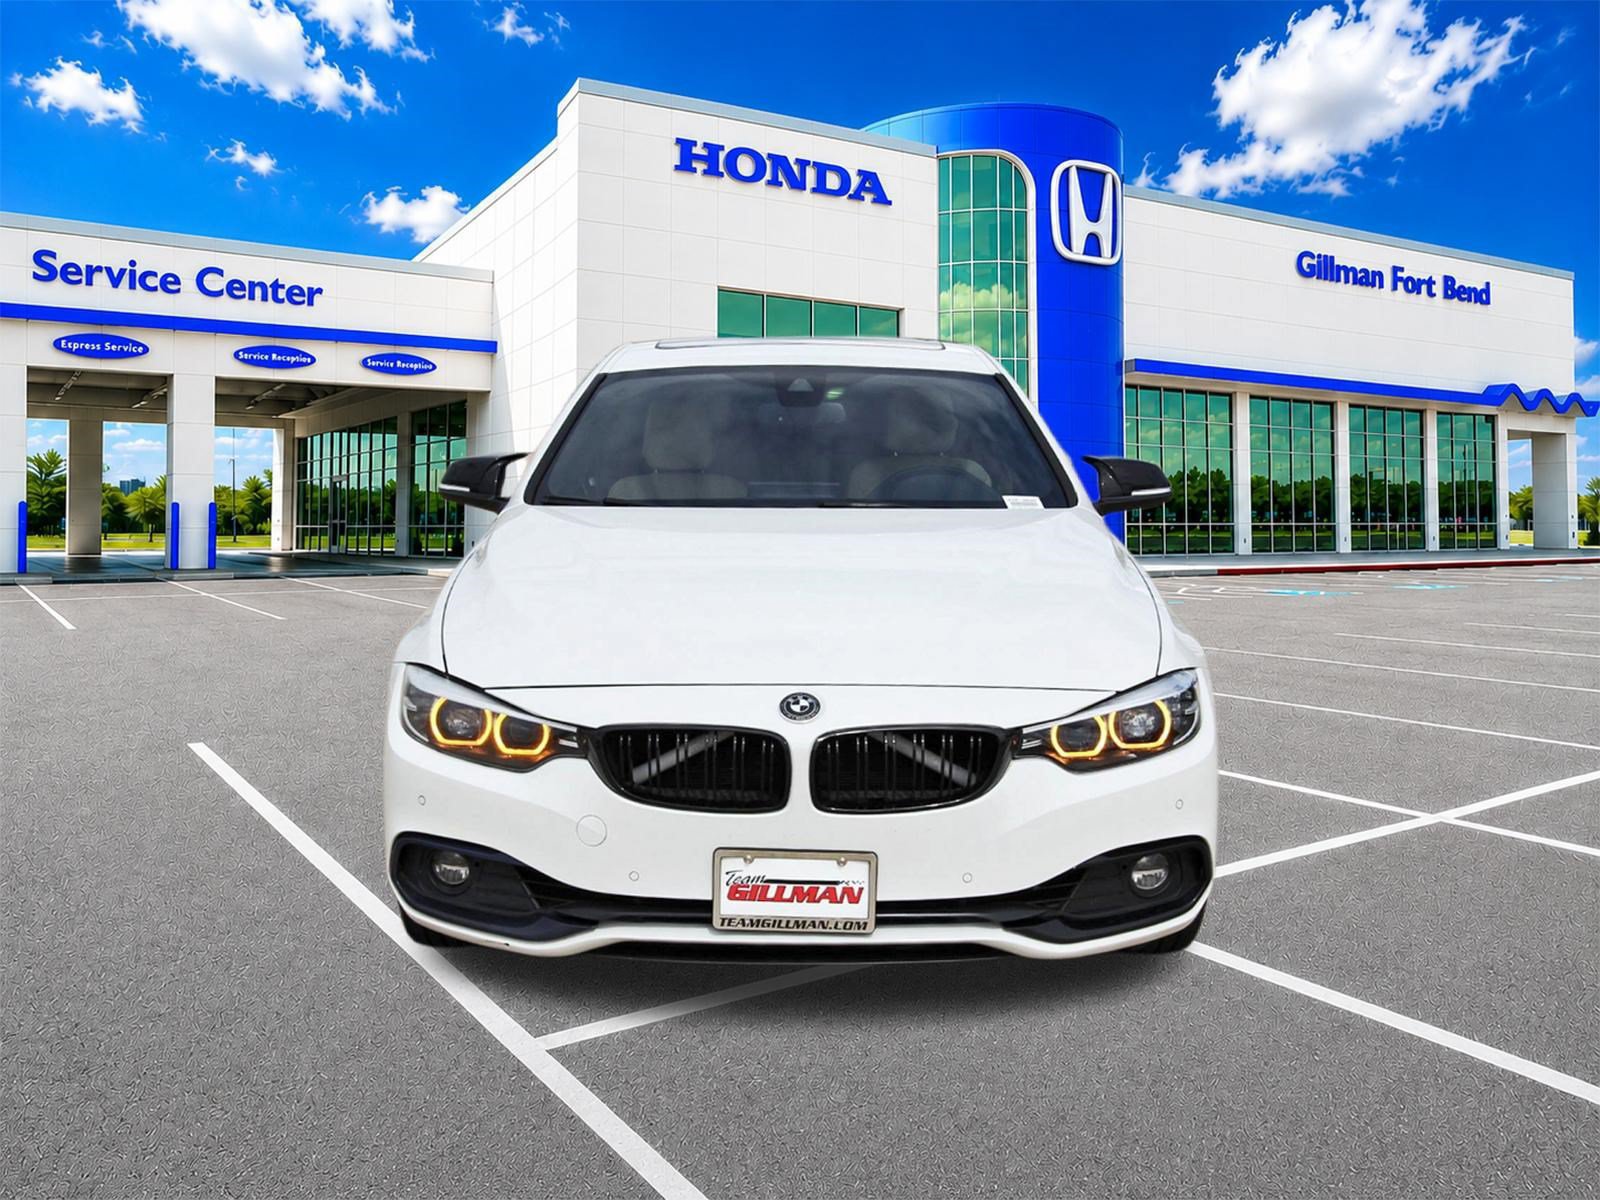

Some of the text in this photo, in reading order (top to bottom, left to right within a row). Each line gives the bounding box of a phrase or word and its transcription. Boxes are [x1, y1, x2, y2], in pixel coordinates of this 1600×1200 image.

[674, 137, 892, 206] HONDA
[32, 249, 323, 307] Service Center
[1296, 250, 1491, 305] Gillman Fort Bend
[104, 342, 144, 354] Service
[238, 351, 269, 361] Service
[725, 869, 766, 887] Team
[727, 884, 864, 905] GILLMAN
[719, 917, 868, 931] TEAMGILLMAN.COM
